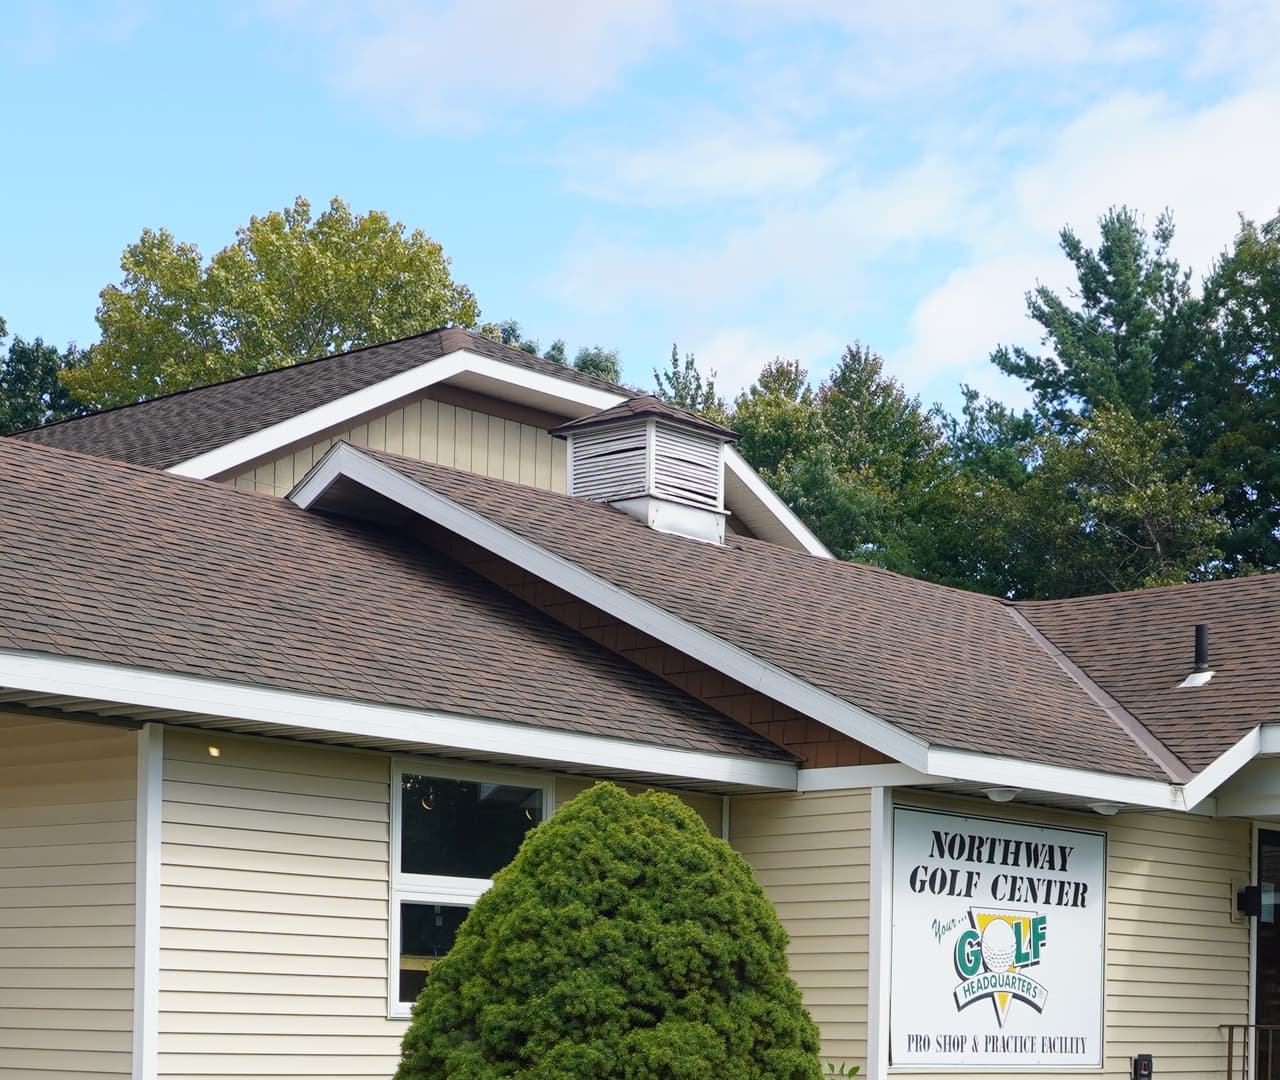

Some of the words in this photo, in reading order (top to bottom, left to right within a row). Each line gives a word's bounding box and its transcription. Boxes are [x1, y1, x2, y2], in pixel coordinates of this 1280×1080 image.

[929, 830, 1074, 872] NORTHWAY
[909, 865, 981, 898] GOLF
[991, 874, 1089, 908] CENTER
[962, 974, 1039, 999] HEADQUARTERS
[907, 1034, 931, 1053] PRO
[935, 1034, 968, 1053] SHOP
[971, 1035, 979, 1053] &
[984, 1035, 1037, 1054] PRACTICE
[1040, 1036, 1087, 1054] FACILITY
